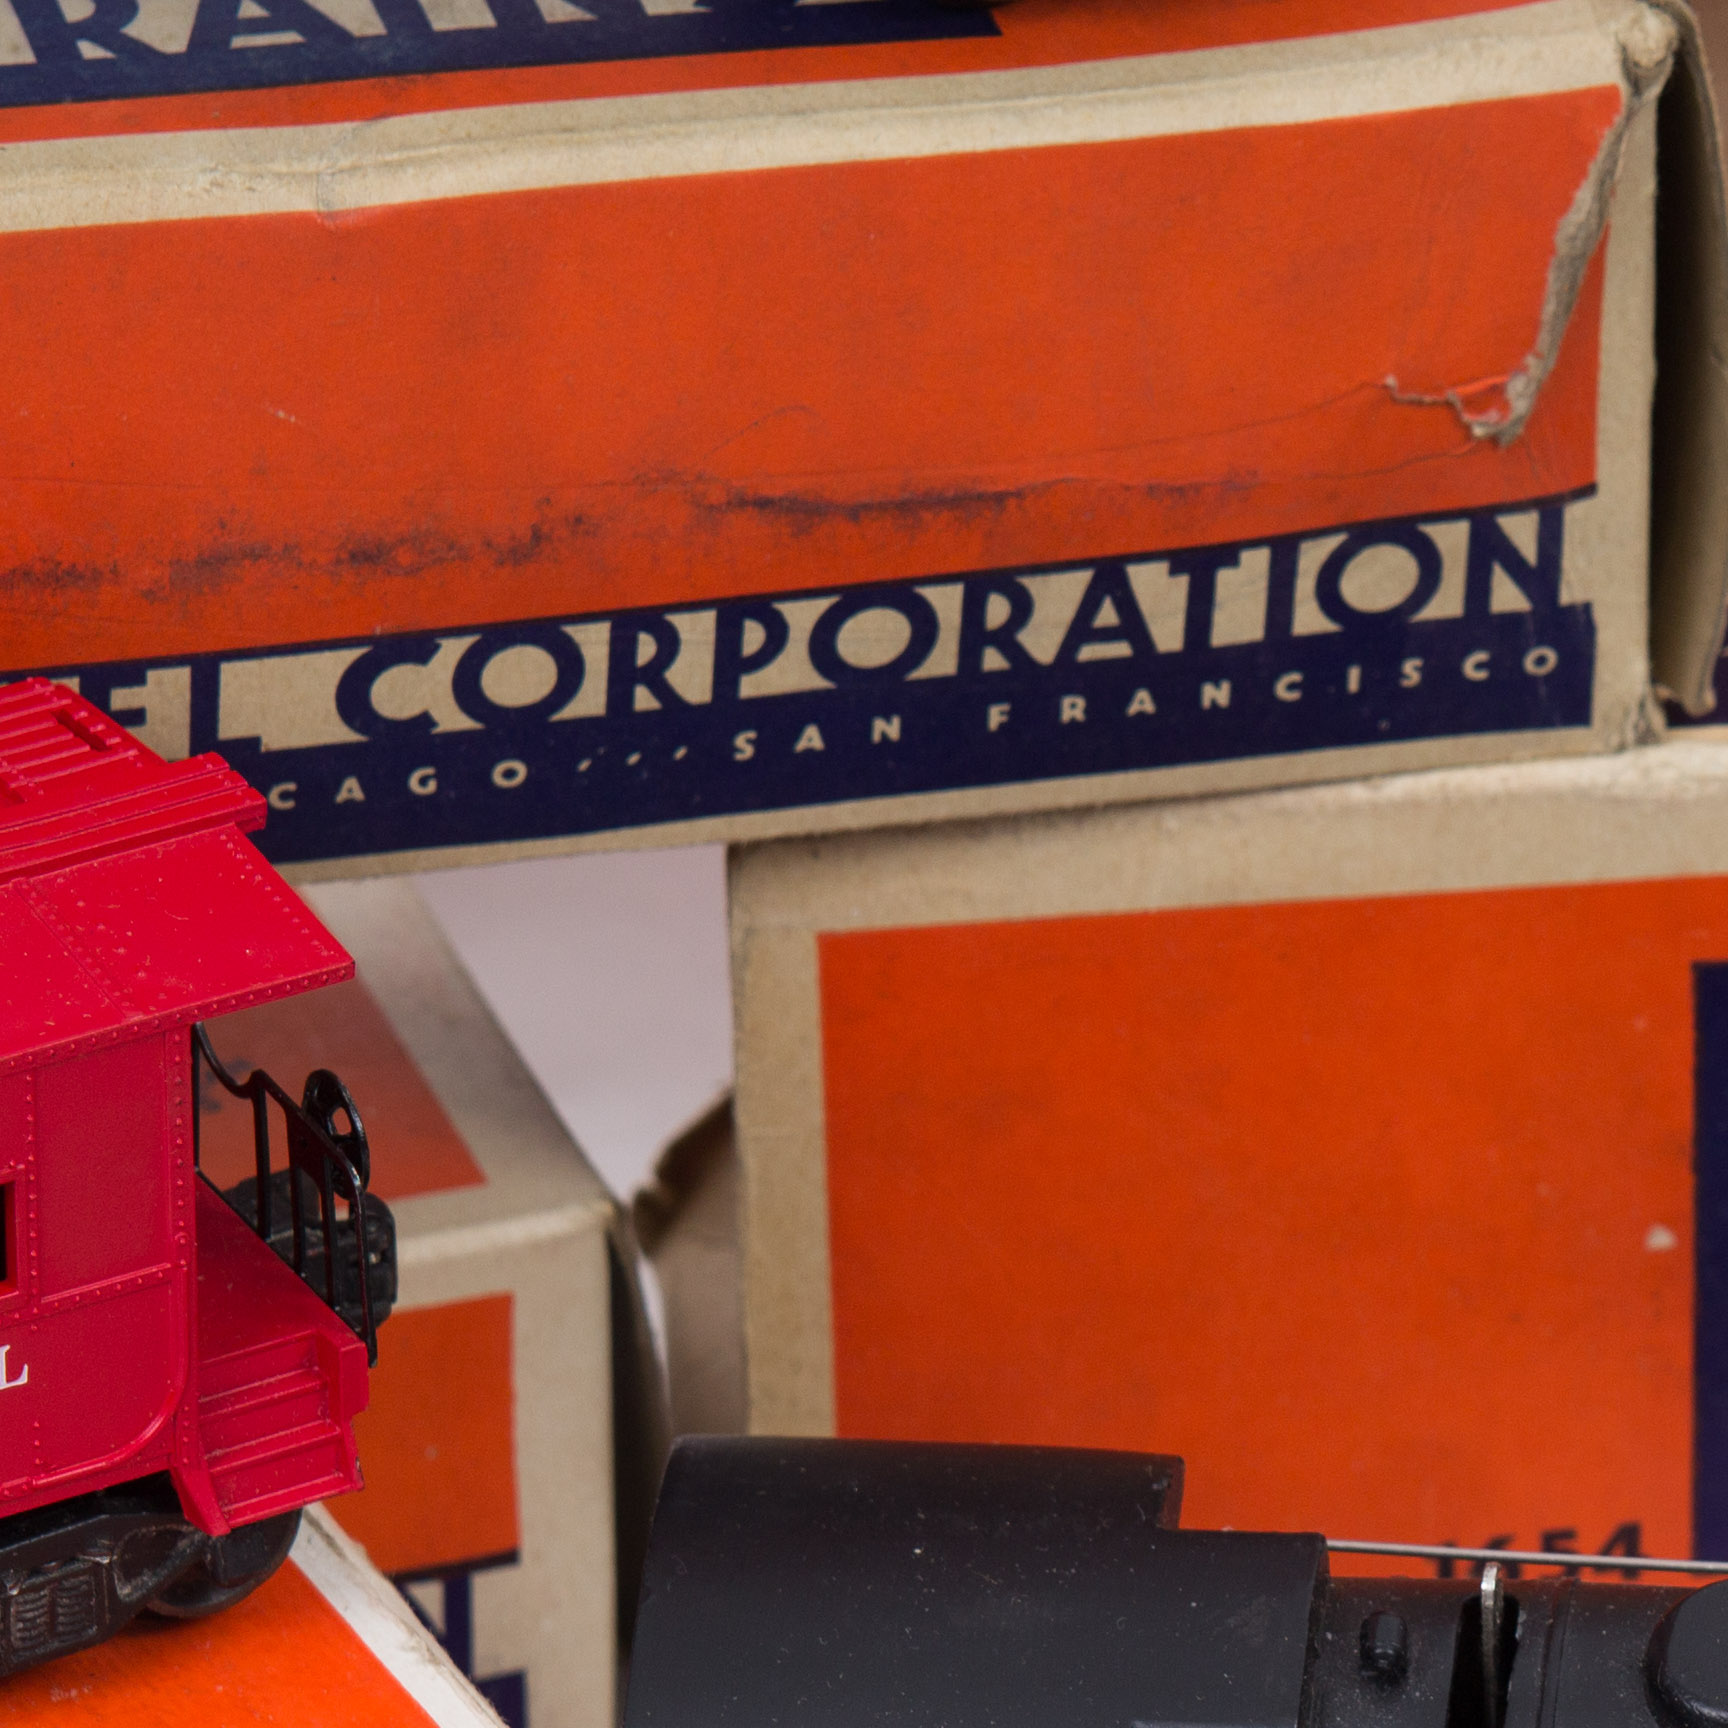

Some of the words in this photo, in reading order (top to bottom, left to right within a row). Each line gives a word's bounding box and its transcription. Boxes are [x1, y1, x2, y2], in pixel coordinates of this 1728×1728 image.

[334, 506, 1568, 744] CORPORATION
[732, 712, 902, 761] SAN
[988, 646, 1558, 733] FRANCISCO
